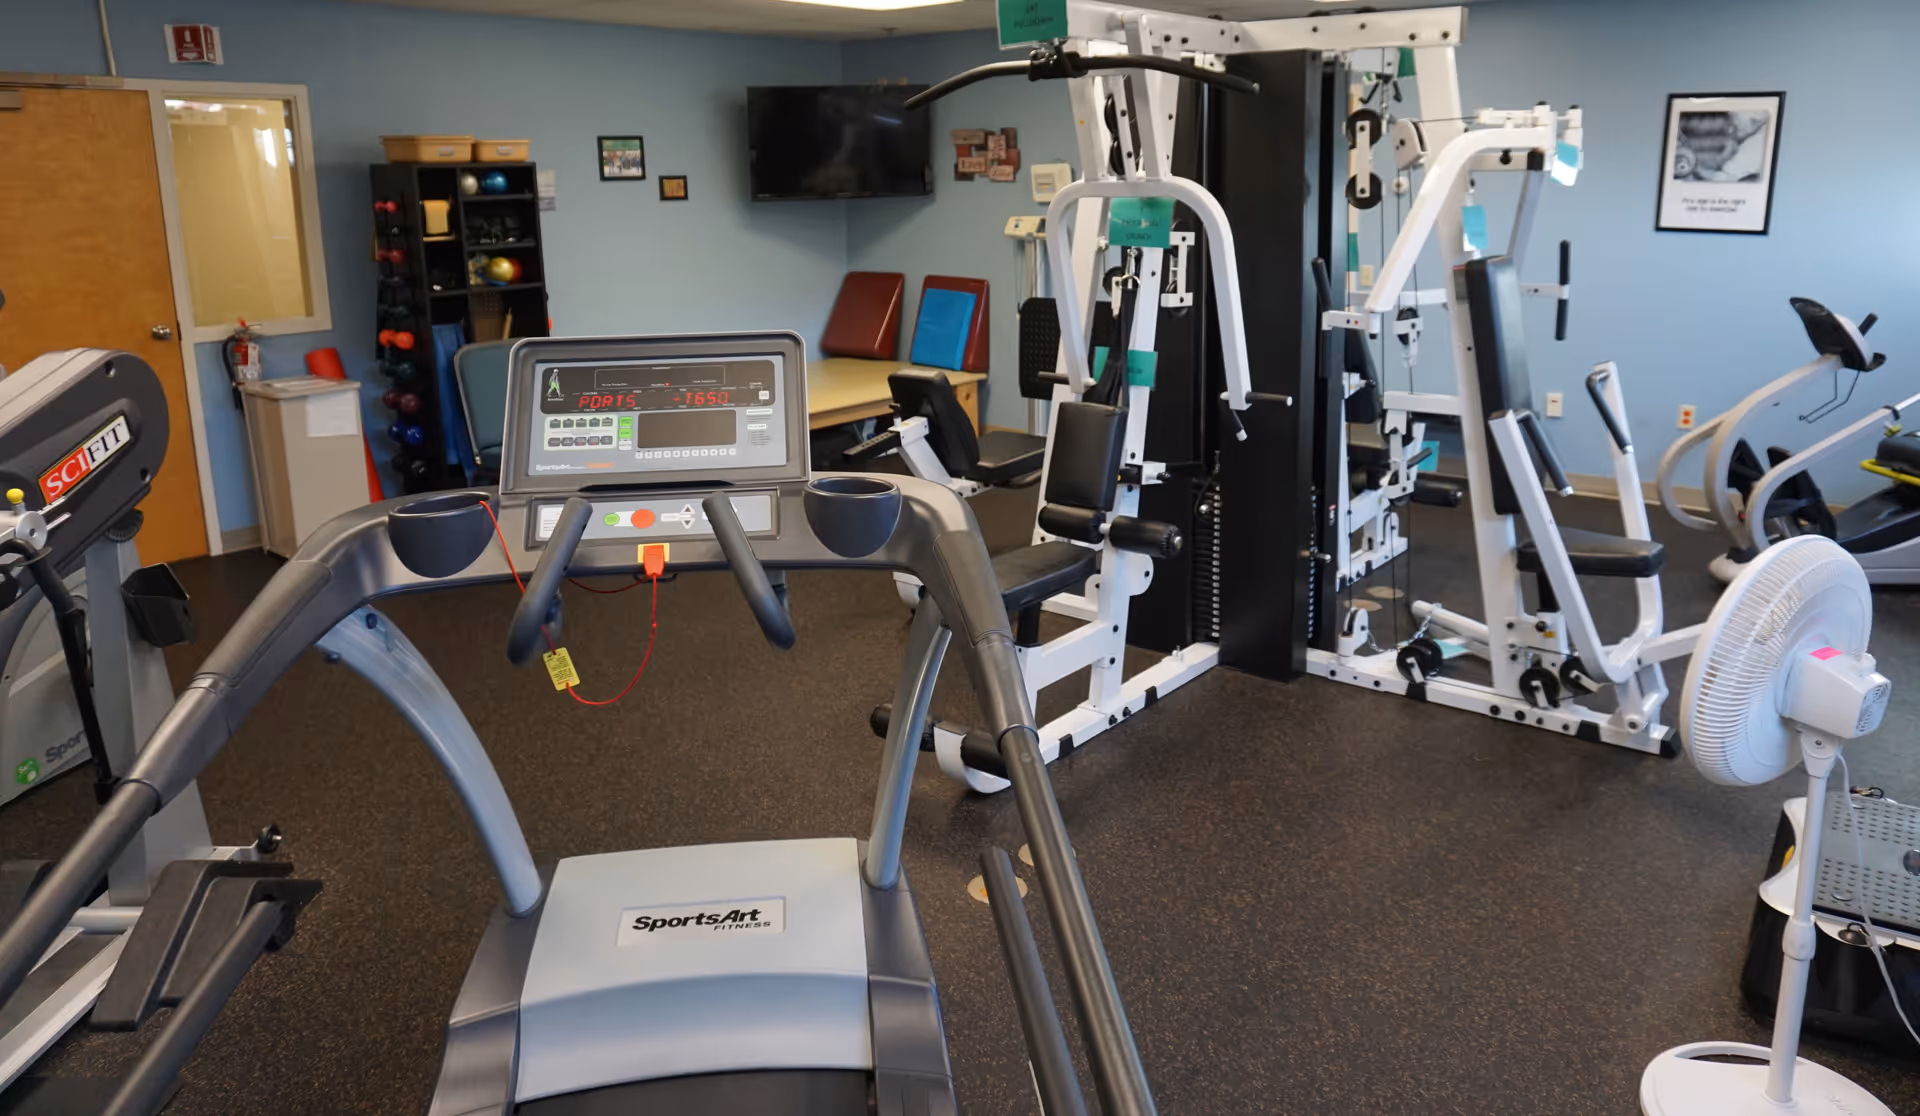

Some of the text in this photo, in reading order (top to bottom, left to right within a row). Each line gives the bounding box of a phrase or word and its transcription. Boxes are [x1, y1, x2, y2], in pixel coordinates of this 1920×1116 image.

[46, 422, 122, 497] SCIFIT
[45, 729, 85, 763] Spor
[632, 908, 762, 932] SportsArt
[713, 921, 771, 931] FITNESS
